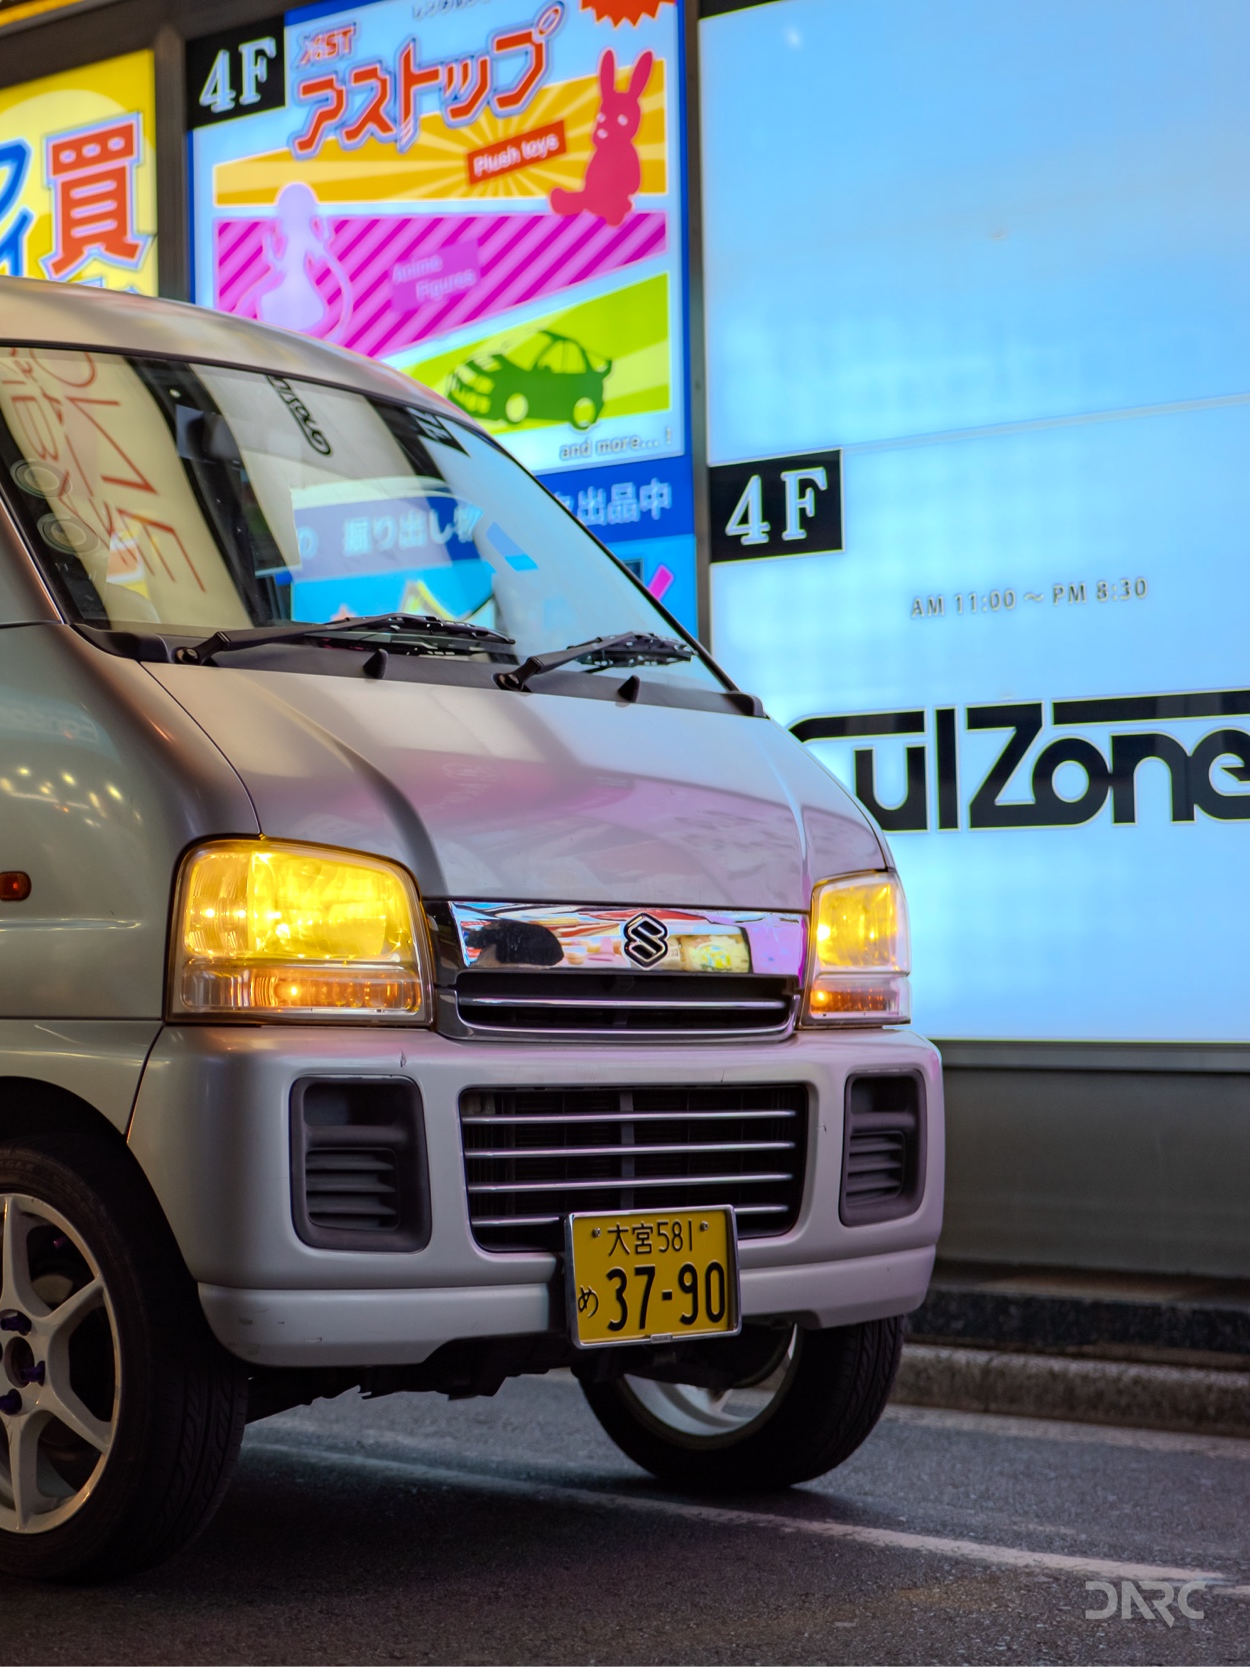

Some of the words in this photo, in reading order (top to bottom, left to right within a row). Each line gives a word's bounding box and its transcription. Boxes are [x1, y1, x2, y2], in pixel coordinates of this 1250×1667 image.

[198, 38, 277, 114] 4F
[287, 2, 566, 162] アストップ
[473, 145, 521, 178] Plush
[521, 133, 560, 159] toys
[40, 112, 154, 294] 買
[560, 437, 592, 461] and
[725, 466, 828, 546] 4F
[910, 595, 946, 619] AM
[954, 589, 1017, 615] 11:00
[1052, 583, 1088, 606] PM
[1096, 576, 1148, 603] 8:30
[577, 1284, 599, 1319] め
[606, 1259, 726, 1332] 37-90
